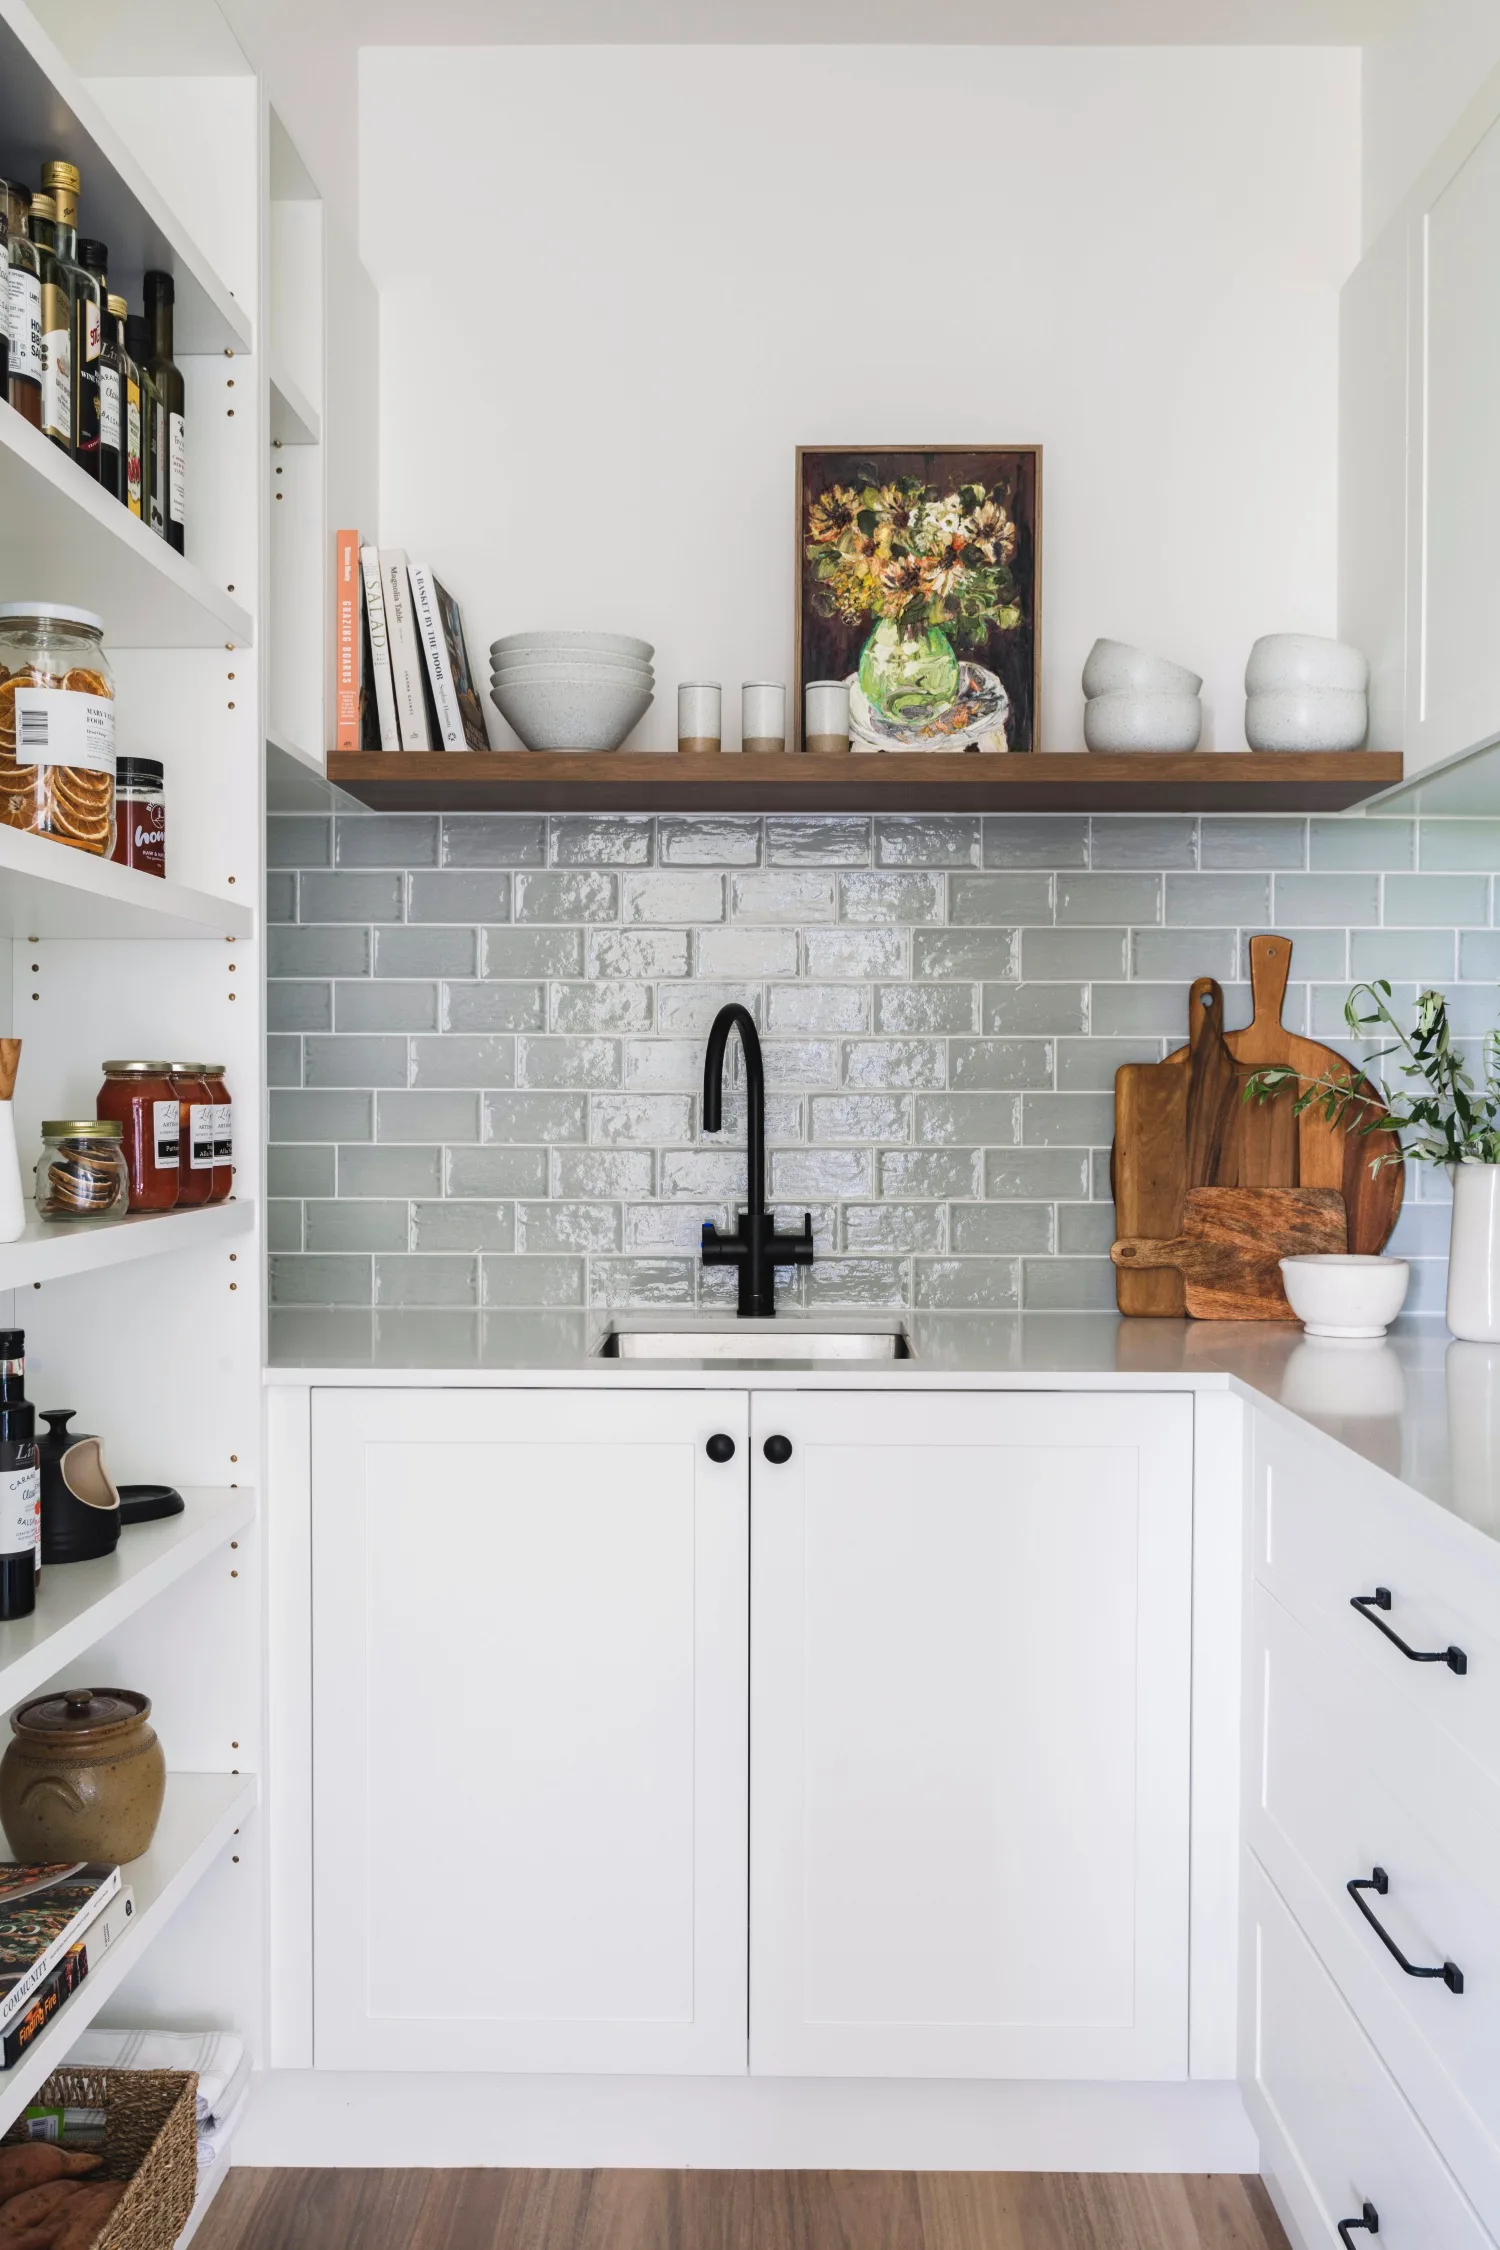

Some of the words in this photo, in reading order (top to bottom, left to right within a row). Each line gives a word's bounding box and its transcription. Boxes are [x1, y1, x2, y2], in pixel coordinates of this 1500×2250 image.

[390, 566, 402, 602] Magnolia
[415, 568, 422, 576] A
[395, 602, 404, 624] Table
[416, 577, 431, 614] BASKET
[342, 600, 352, 642] GRAZING
[366, 580, 386, 648] SALAD
[424, 615, 434, 632] BY
[427, 631, 438, 651] THE
[342, 646, 352, 683] BOARDS
[431, 652, 444, 681] DOOR
[86, 716, 104, 726] FOOD
[3, 1958, 48, 2018] COMMUNITY
[19, 2007, 45, 2047] Finding
[44, 1993, 57, 2014] Fire
